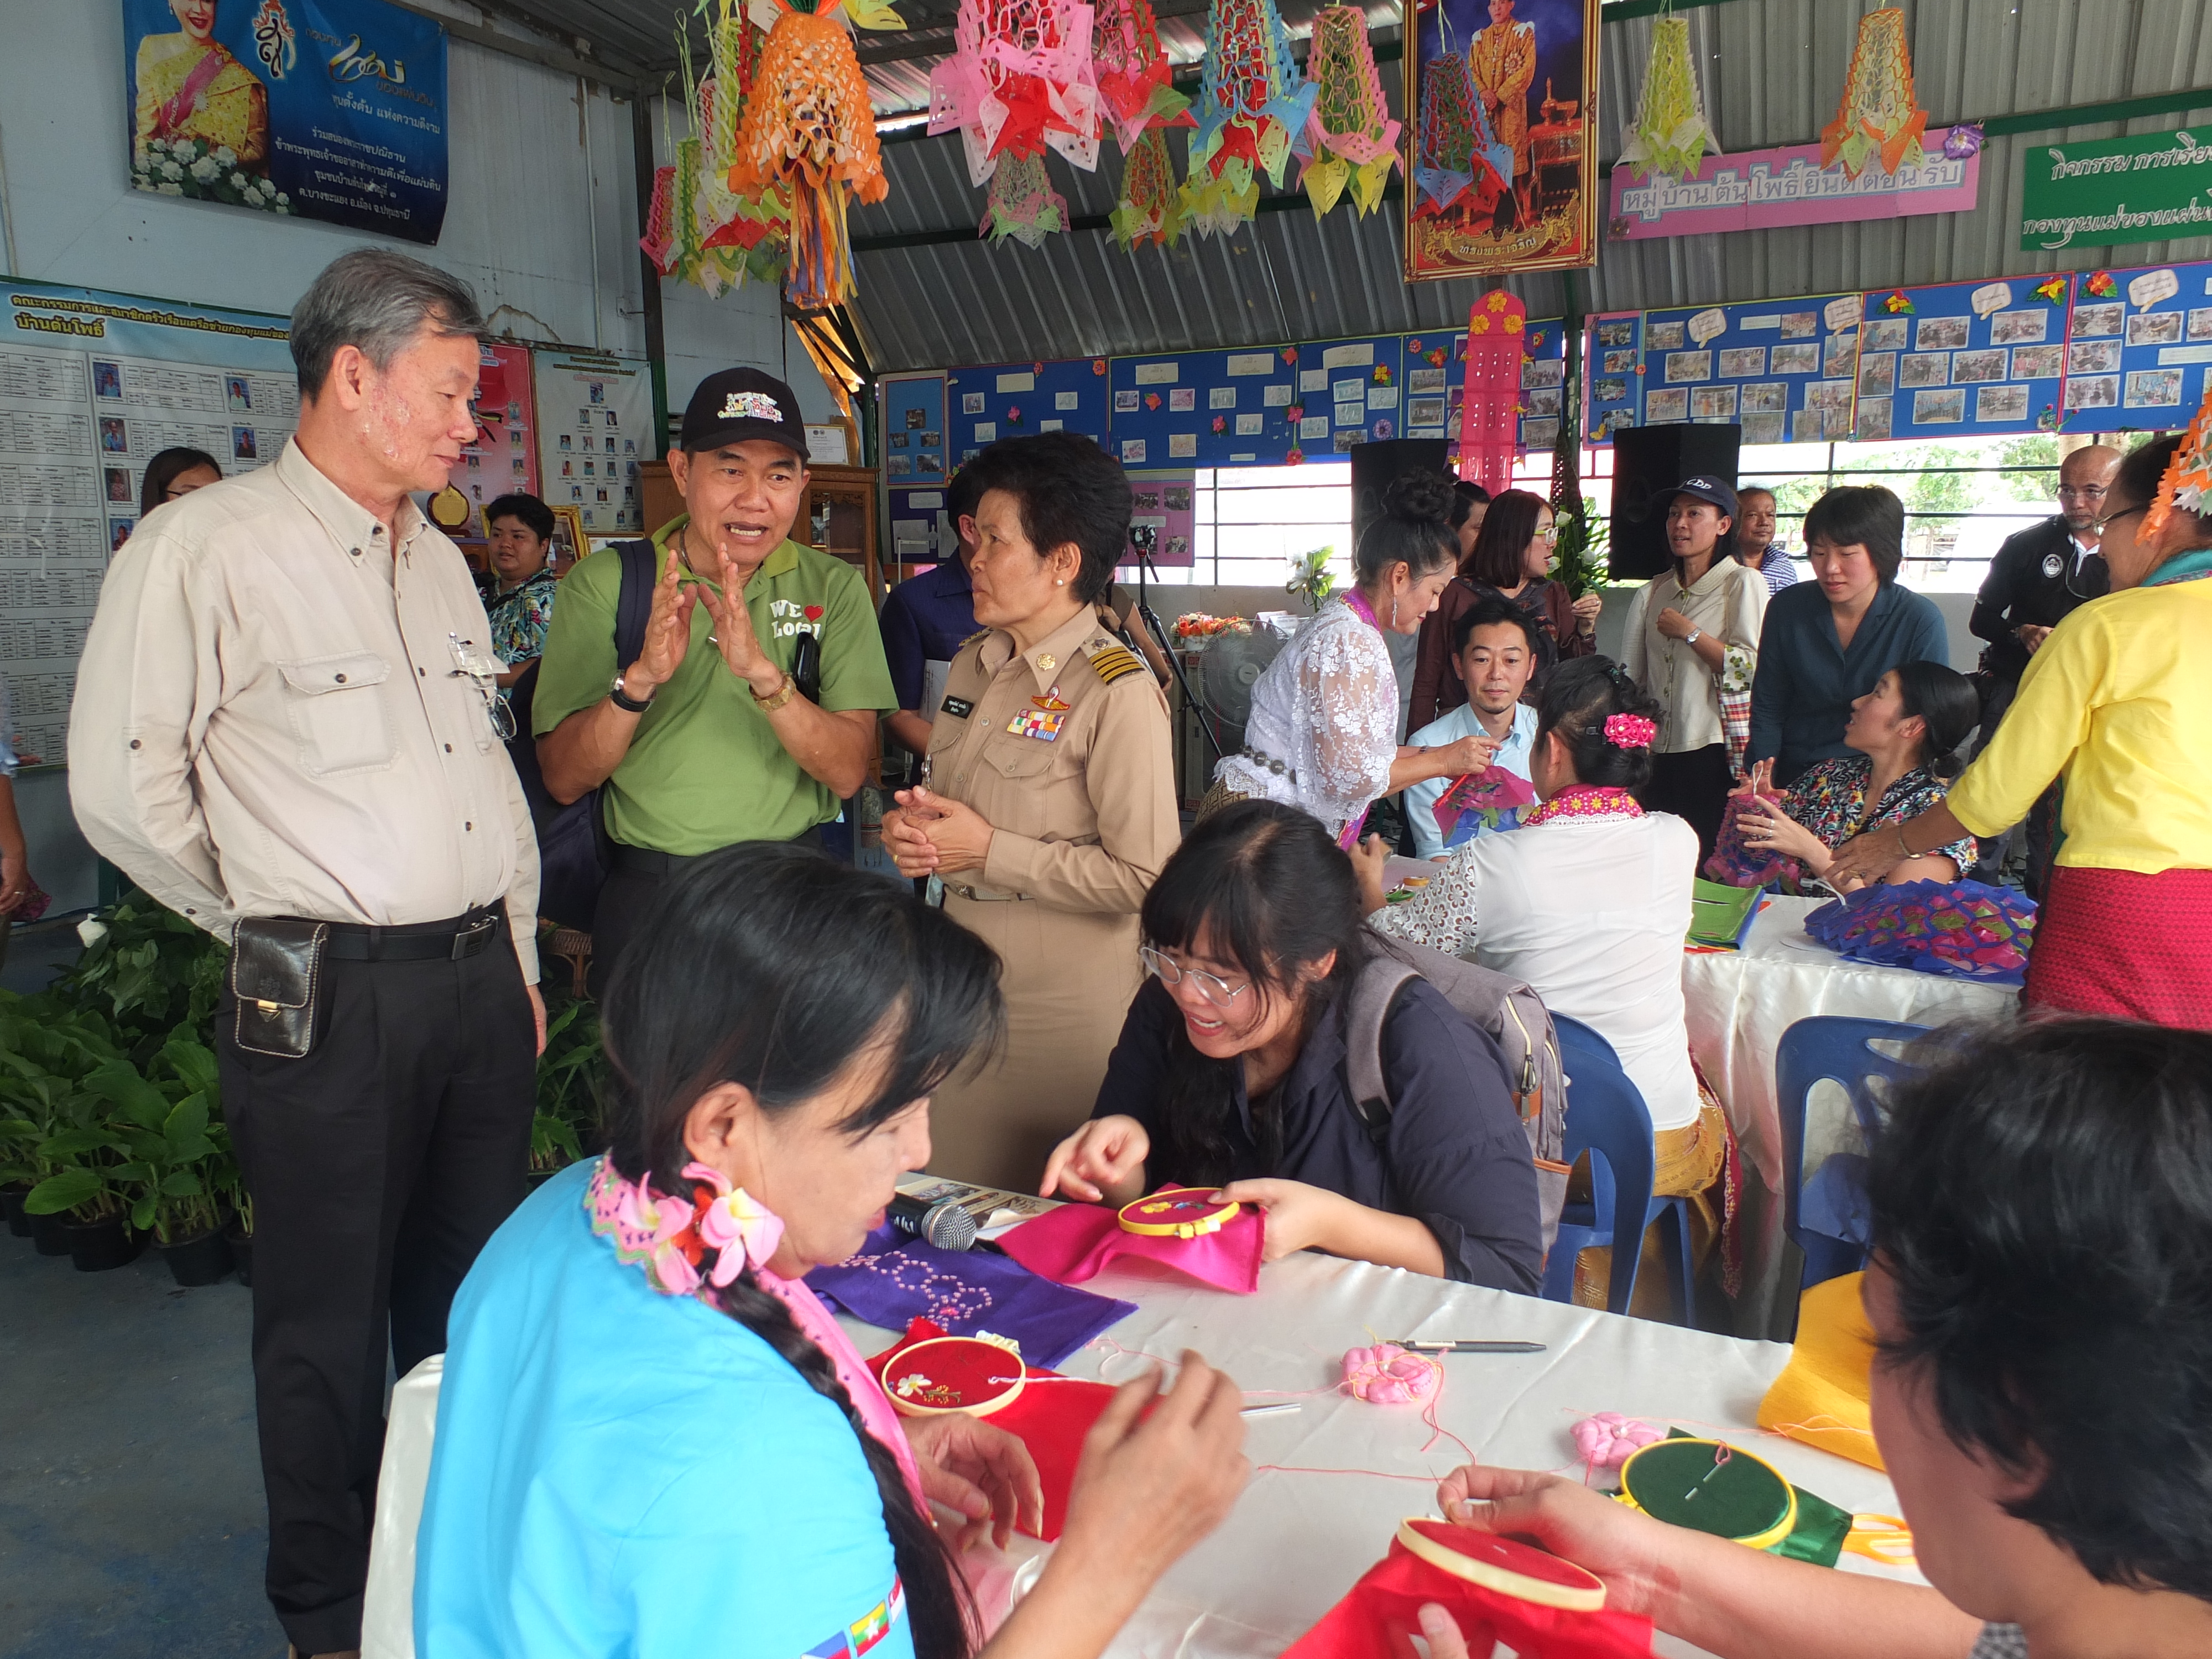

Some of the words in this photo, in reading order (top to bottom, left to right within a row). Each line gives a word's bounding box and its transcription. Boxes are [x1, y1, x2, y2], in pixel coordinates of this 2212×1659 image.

[2048, 148, 2132, 181] กิจกรรม
[2133, 131, 2212, 170] การเรีย
[1459, 237, 1536, 256] ทรงพระเจริญ
[770, 599, 802, 618] WE
